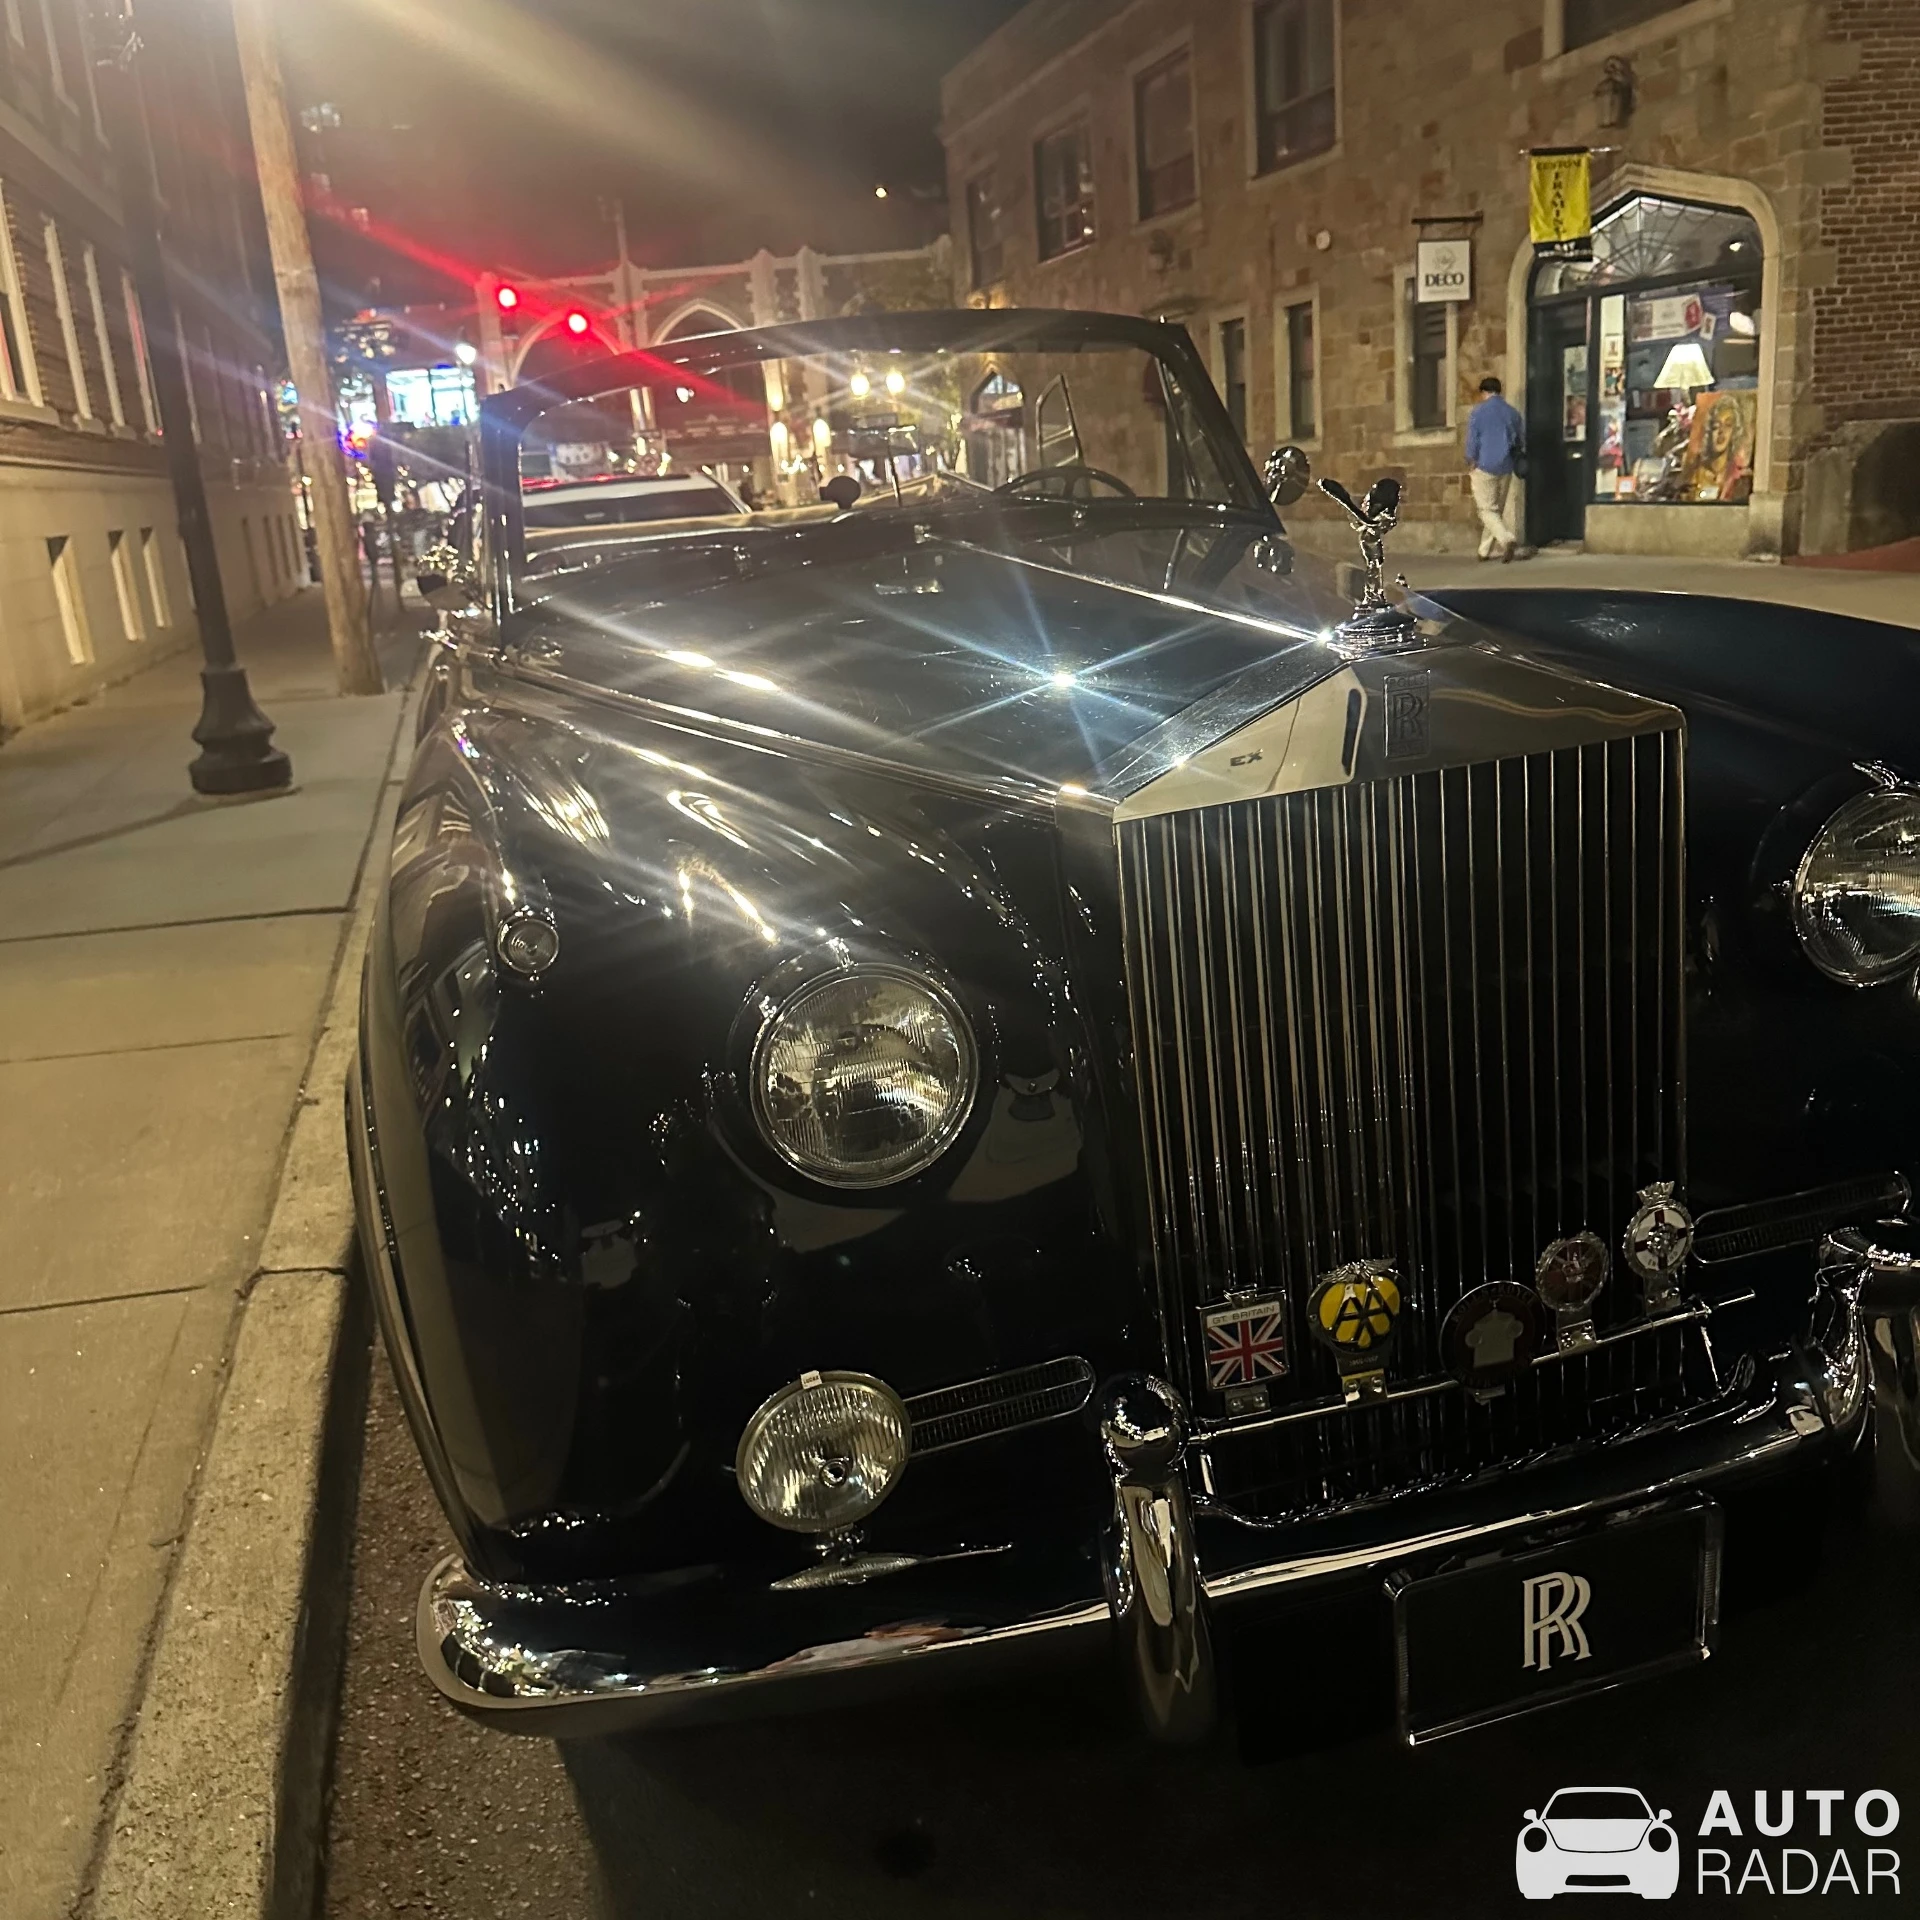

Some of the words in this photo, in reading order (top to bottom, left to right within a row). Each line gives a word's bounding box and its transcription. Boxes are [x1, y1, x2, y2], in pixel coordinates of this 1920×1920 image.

[1425, 272, 1464, 287] DECO
[1230, 749, 1263, 766] EX
[1232, 1304, 1276, 1320] BRITAIN
[1329, 1284, 1397, 1341] AA
[1522, 1571, 1593, 1672] RR
